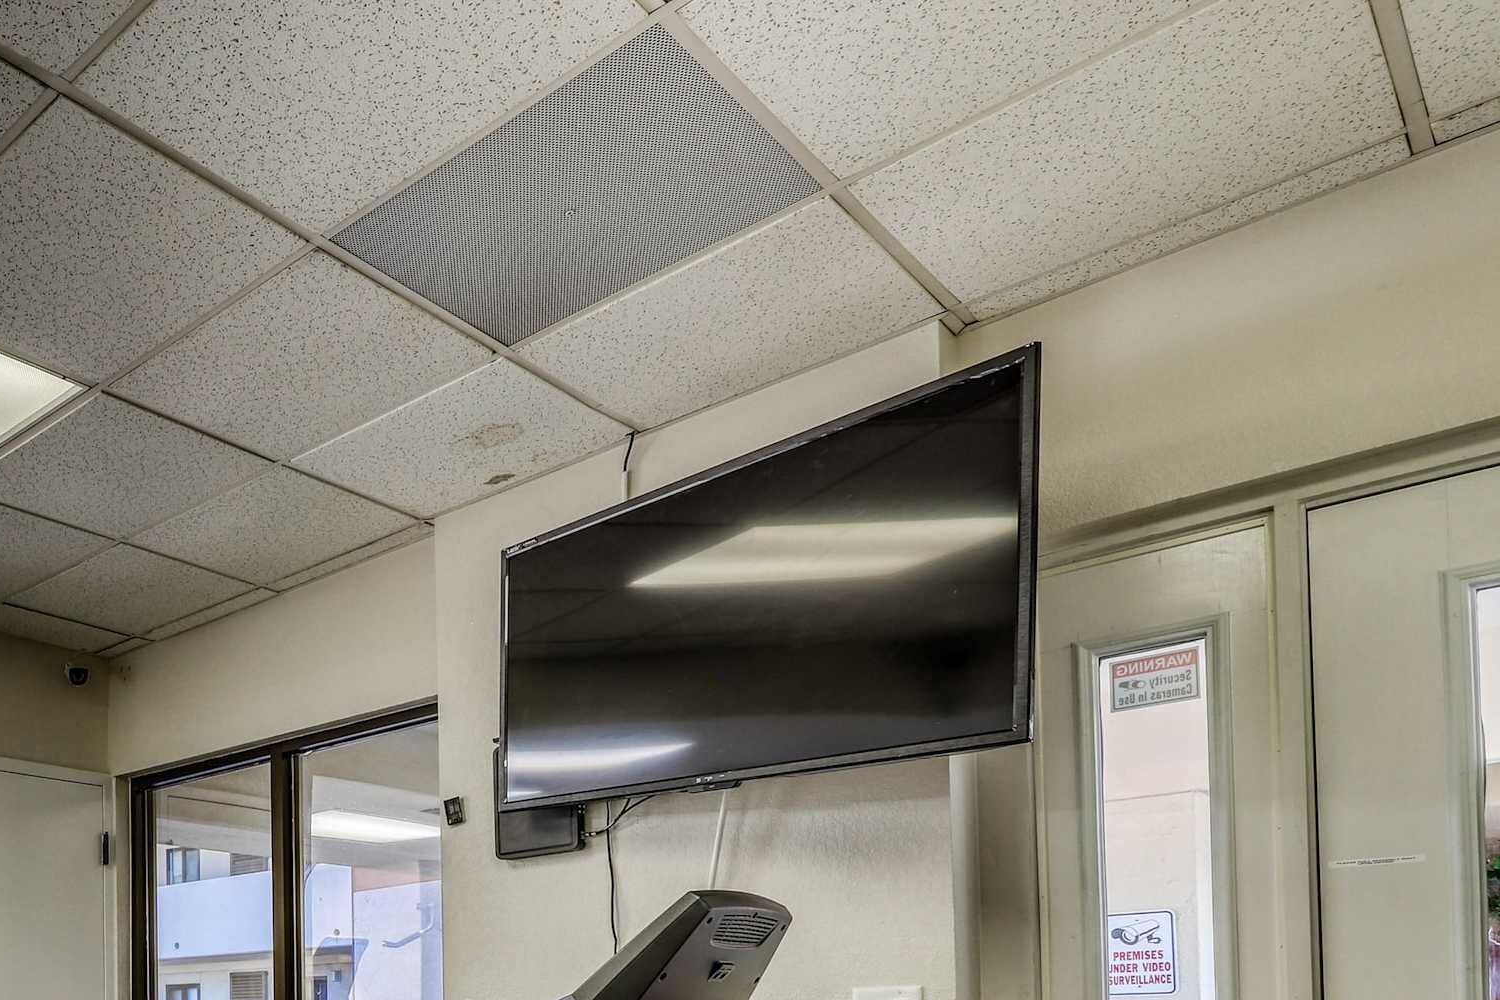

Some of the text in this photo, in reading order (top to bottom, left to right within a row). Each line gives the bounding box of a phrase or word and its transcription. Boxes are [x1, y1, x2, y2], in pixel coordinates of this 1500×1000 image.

[1113, 950, 1164, 961] PREMISES
[1143, 961, 1171, 972] VIDEO
[1108, 974, 1172, 986] SURVEILLANCE
